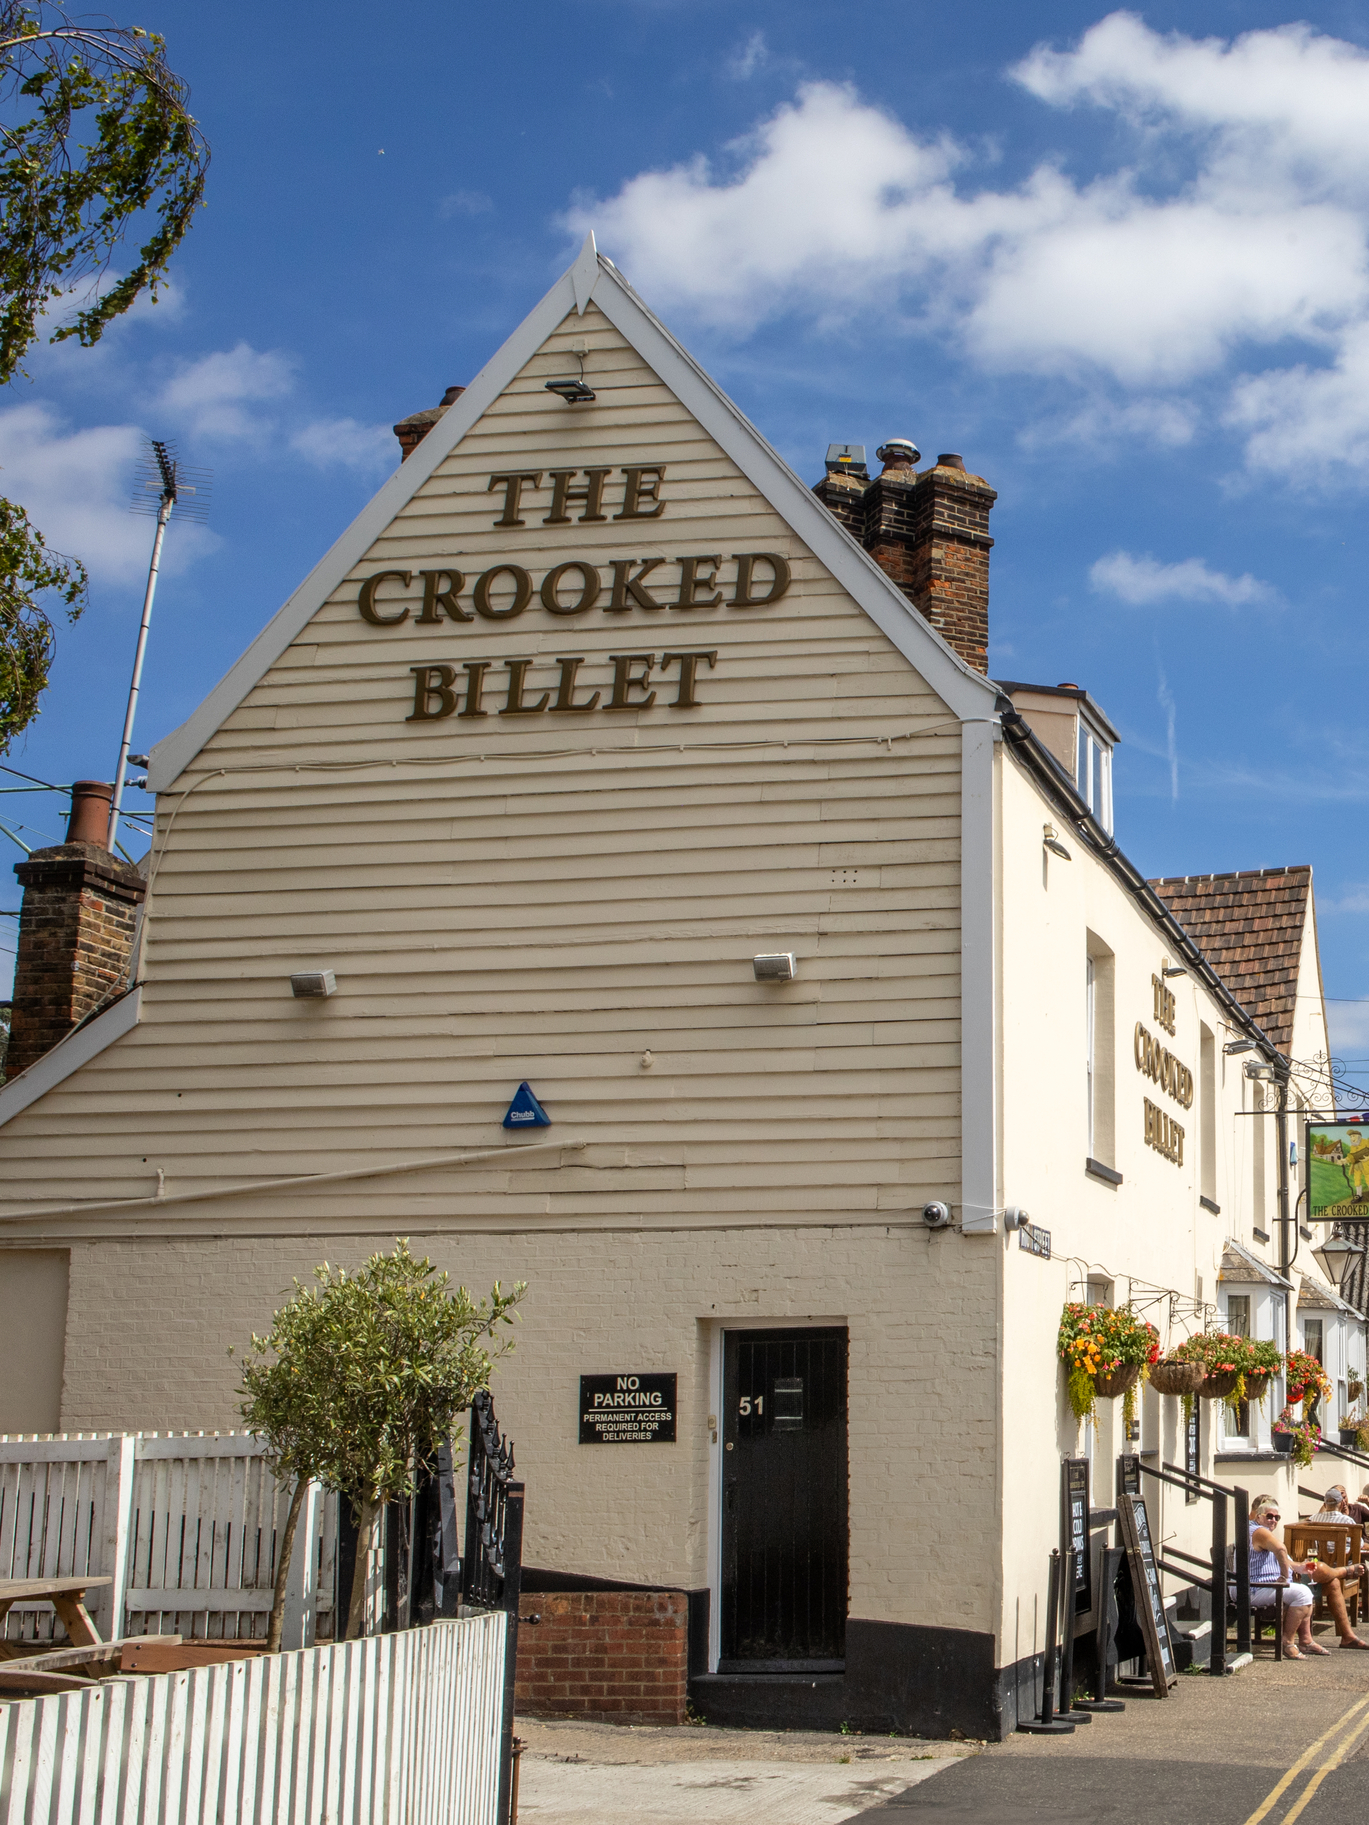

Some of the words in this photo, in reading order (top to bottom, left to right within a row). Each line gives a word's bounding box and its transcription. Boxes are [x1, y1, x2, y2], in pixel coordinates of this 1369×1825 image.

[488, 465, 667, 527] THE
[358, 552, 792, 626] CROOKED
[405, 650, 719, 722] BILLET
[1152, 973, 1176, 1038] THE
[1134, 1021, 1193, 1111] CROOKED
[510, 1110, 535, 1119] Chubb
[1143, 1096, 1186, 1168] BILLET
[1313, 1205, 1328, 1217] THE
[1331, 1204, 1369, 1216] CROOKED
[616, 1376, 640, 1390] NO
[594, 1392, 662, 1407] PARKING
[738, 1395, 764, 1416] 51
[583, 1413, 636, 1422] PERMANENT
[637, 1412, 672, 1421] ACCESS
[595, 1422, 640, 1432] REQUIRED
[640, 1421, 659, 1431] FOR
[602, 1431, 652, 1441] DELIVERIES
